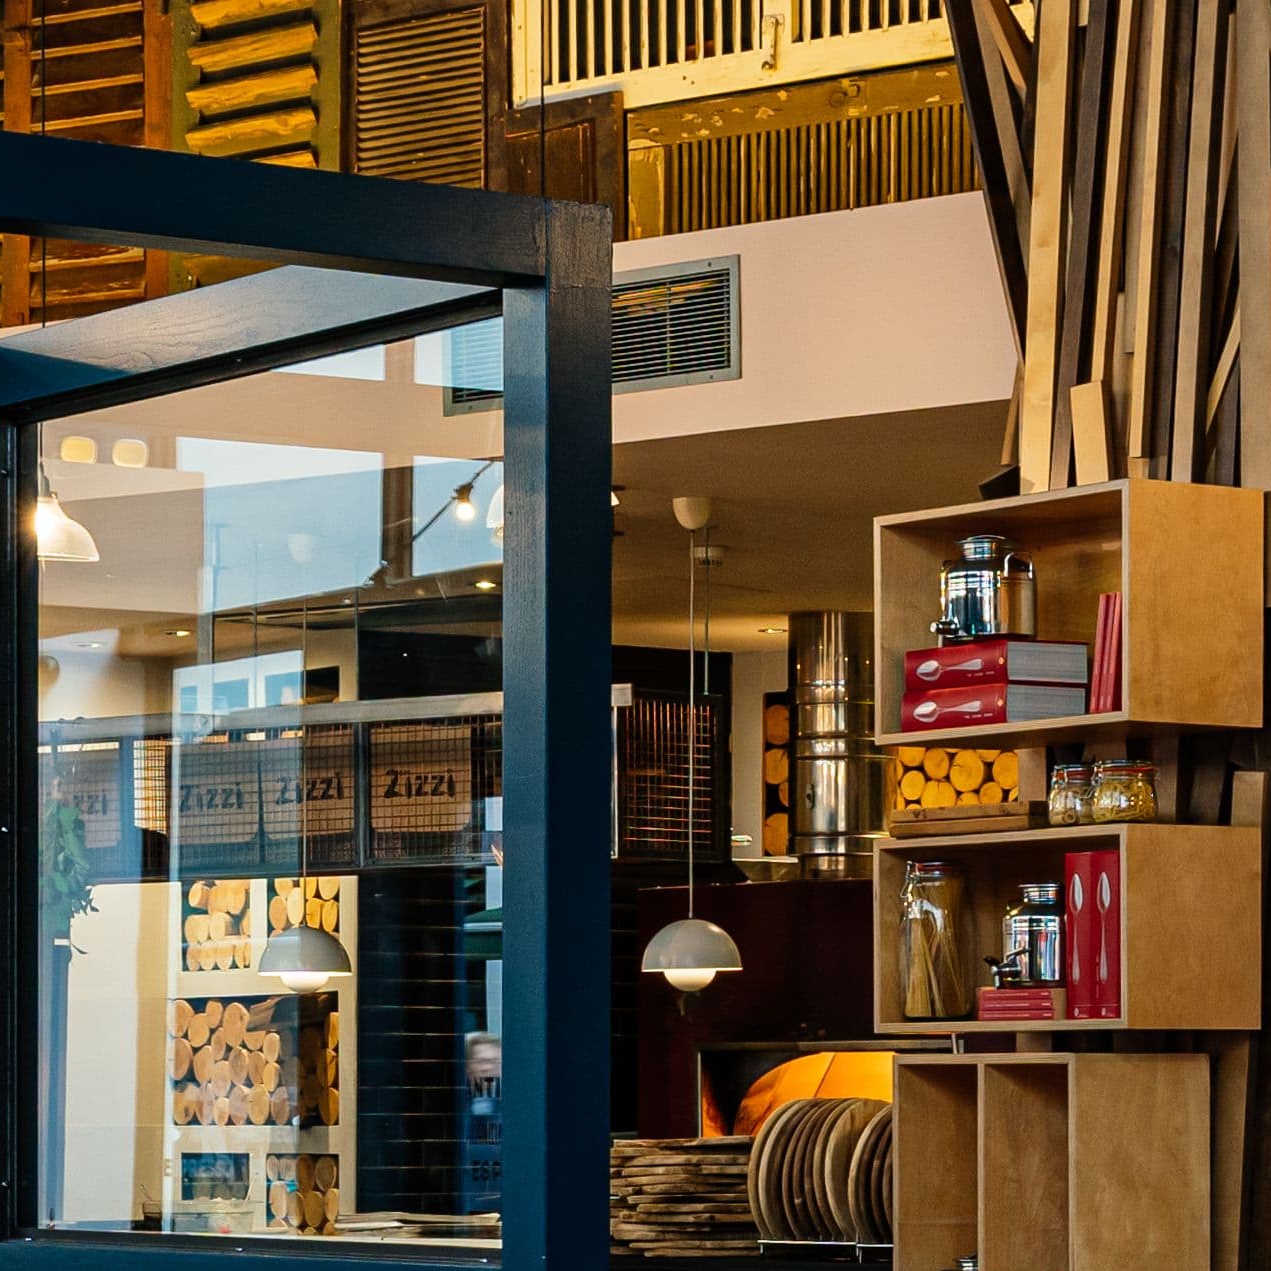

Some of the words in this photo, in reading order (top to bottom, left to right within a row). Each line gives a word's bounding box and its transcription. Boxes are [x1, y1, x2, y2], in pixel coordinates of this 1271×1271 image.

[179, 781, 244, 812] Zizzi
[276, 771, 344, 805] Zizzi
[384, 769, 456, 799] Zizzi
